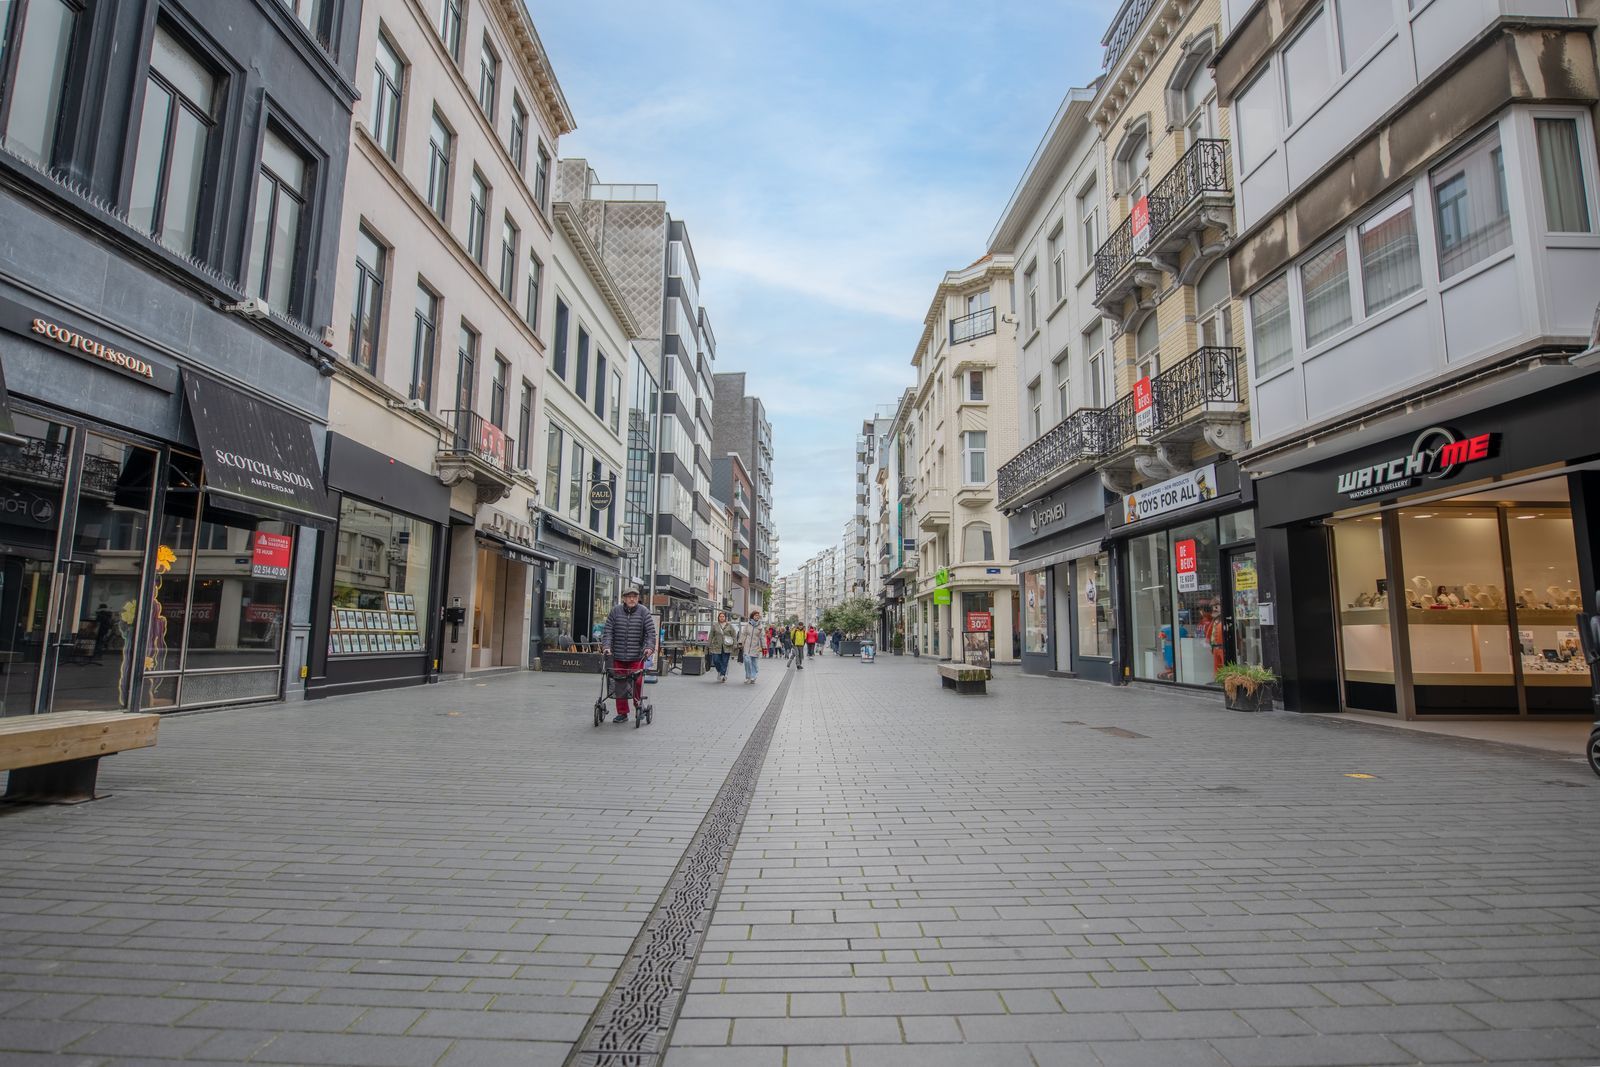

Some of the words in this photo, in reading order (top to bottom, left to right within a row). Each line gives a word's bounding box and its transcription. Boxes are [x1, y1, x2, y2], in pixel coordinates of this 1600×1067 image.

[1136, 384, 1143, 397] DE
[1138, 393, 1150, 409] BEUS
[215, 449, 272, 478] SCOTCH
[281, 470, 314, 490] SODA
[1337, 451, 1424, 494] WATCH
[1440, 432, 1490, 468] ME
[251, 477, 295, 495] AMSTERDAM
[1350, 488, 1372, 499] WATCHES
[1373, 487, 1378, 495] &
[1379, 479, 1409, 492] JEWELLERY
[1138, 495, 1159, 514] TOYS
[1160, 490, 1178, 508] FOR
[1180, 484, 1197, 501] ALL
[508, 550, 516, 559] N
[1179, 545, 1187, 557] DE
[544, 561, 551, 569] N
[1180, 557, 1194, 570] BEUS
[253, 565, 261, 574] 02
[262, 566, 271, 575] 514
[272, 567, 279, 575] 40
[279, 568, 287, 576] 00
[971, 620, 988, 629] 30%
